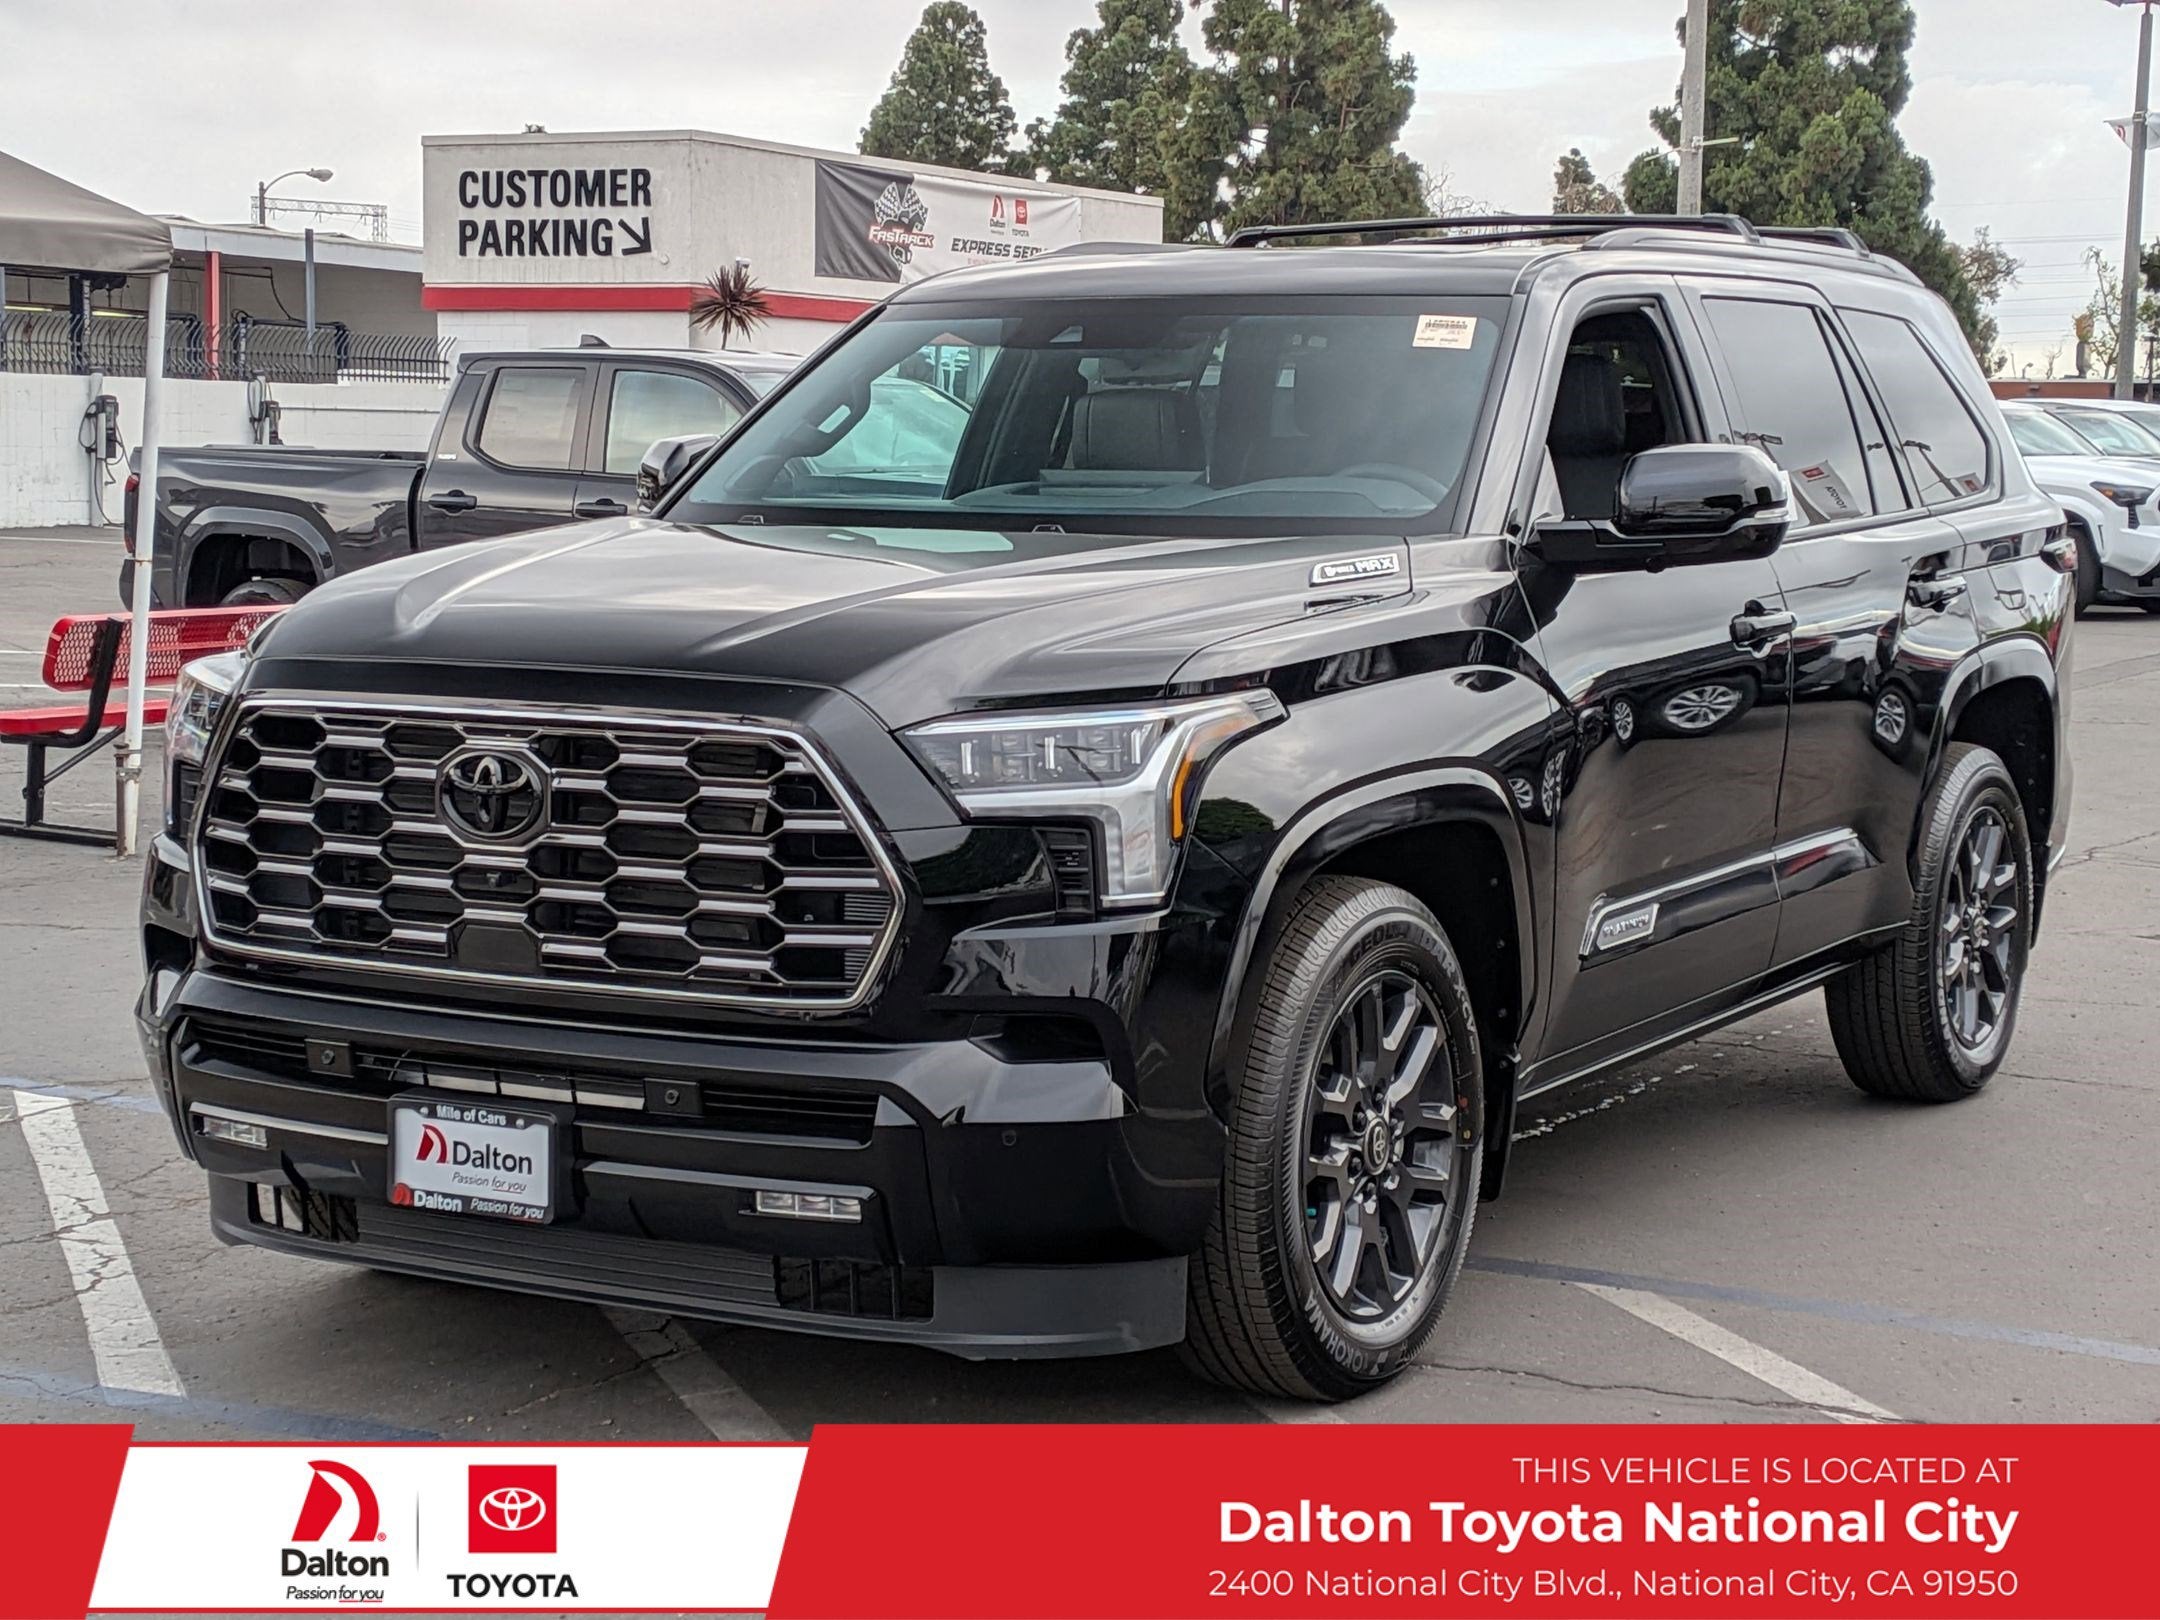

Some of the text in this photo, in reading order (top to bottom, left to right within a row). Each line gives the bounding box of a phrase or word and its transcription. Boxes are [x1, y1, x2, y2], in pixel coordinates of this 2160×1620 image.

[458, 168, 652, 208] CUSTOMER
[458, 218, 613, 257] PARKING
[951, 238, 1012, 257] EXPRESS
[1355, 559, 1394, 573] MAX
[436, 1105, 507, 1126] Mile of Cars
[452, 1140, 533, 1175] Dalton
[452, 1171, 528, 1193] Passion for you
[413, 1190, 463, 1213] Dalton
[470, 1198, 545, 1219] Passion for you
